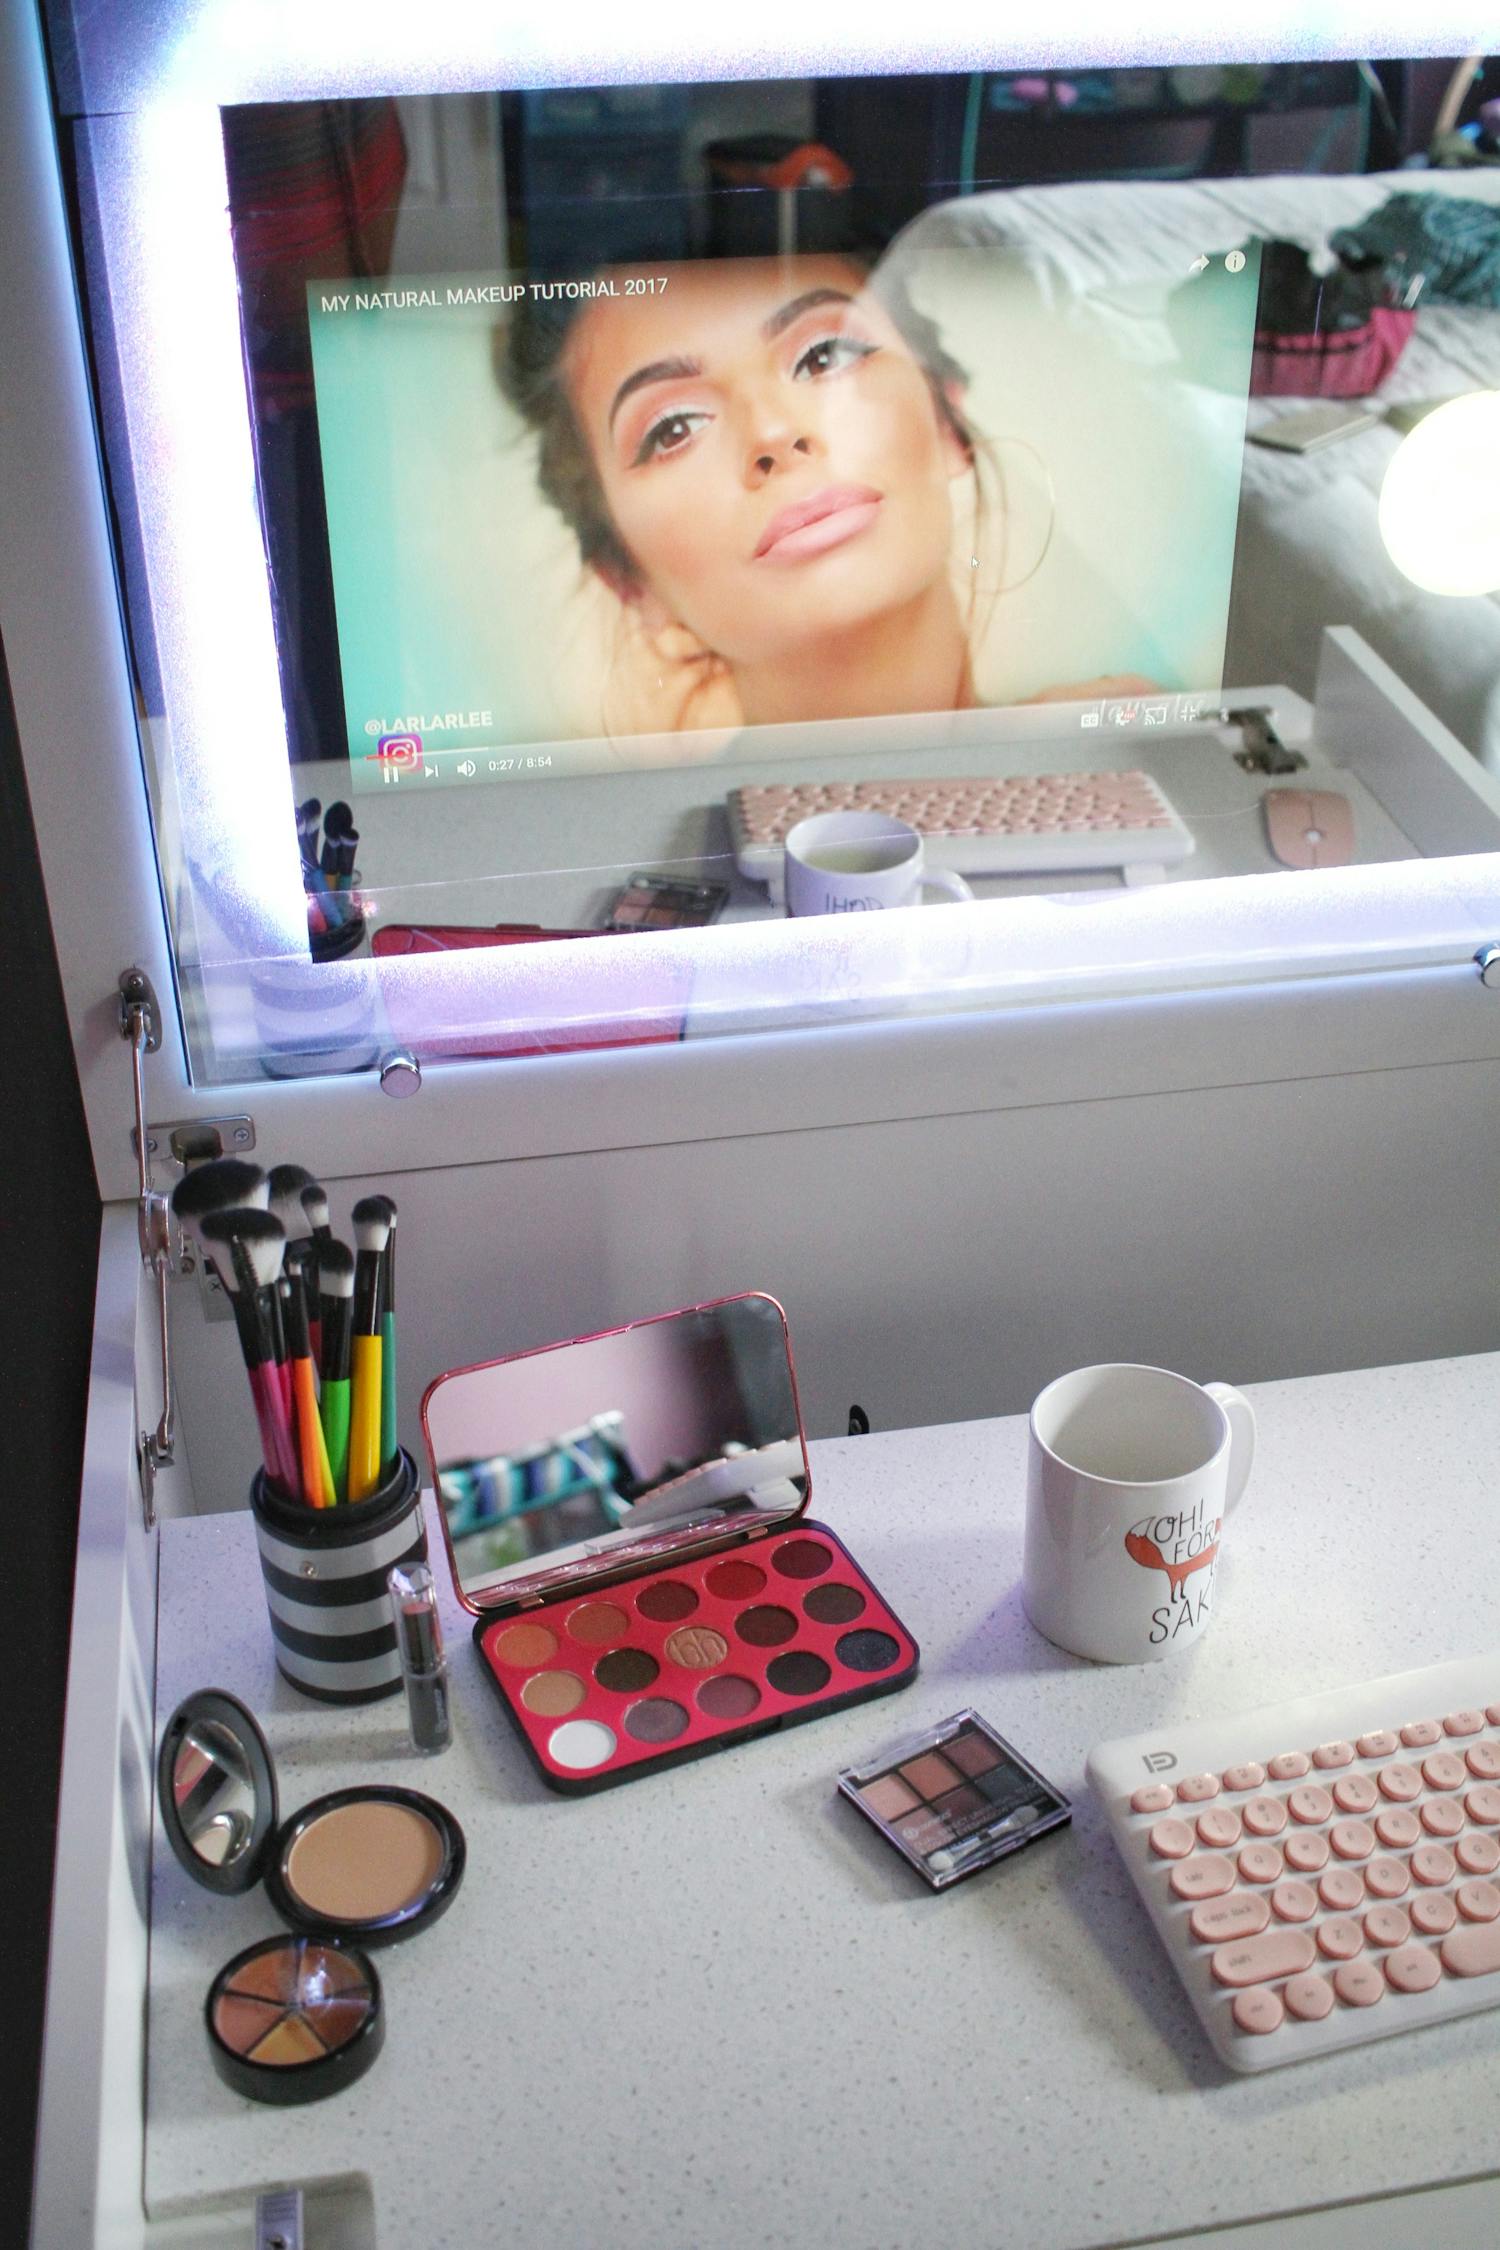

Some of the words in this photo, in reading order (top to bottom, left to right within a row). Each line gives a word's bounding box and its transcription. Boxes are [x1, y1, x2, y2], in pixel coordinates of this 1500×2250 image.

[321, 295, 351, 313] MY
[355, 289, 443, 310] NATURAL
[446, 285, 526, 306] MAKEUP
[529, 280, 620, 302] TUTORIAL
[624, 277, 669, 298] 2017
[364, 711, 493, 736] @LARLARLEE
[488, 759, 514, 772] 0:27
[526, 756, 552, 769] 8:54
[1154, 1498, 1203, 1543] OH!
[1174, 1519, 1214, 1563] FOR
